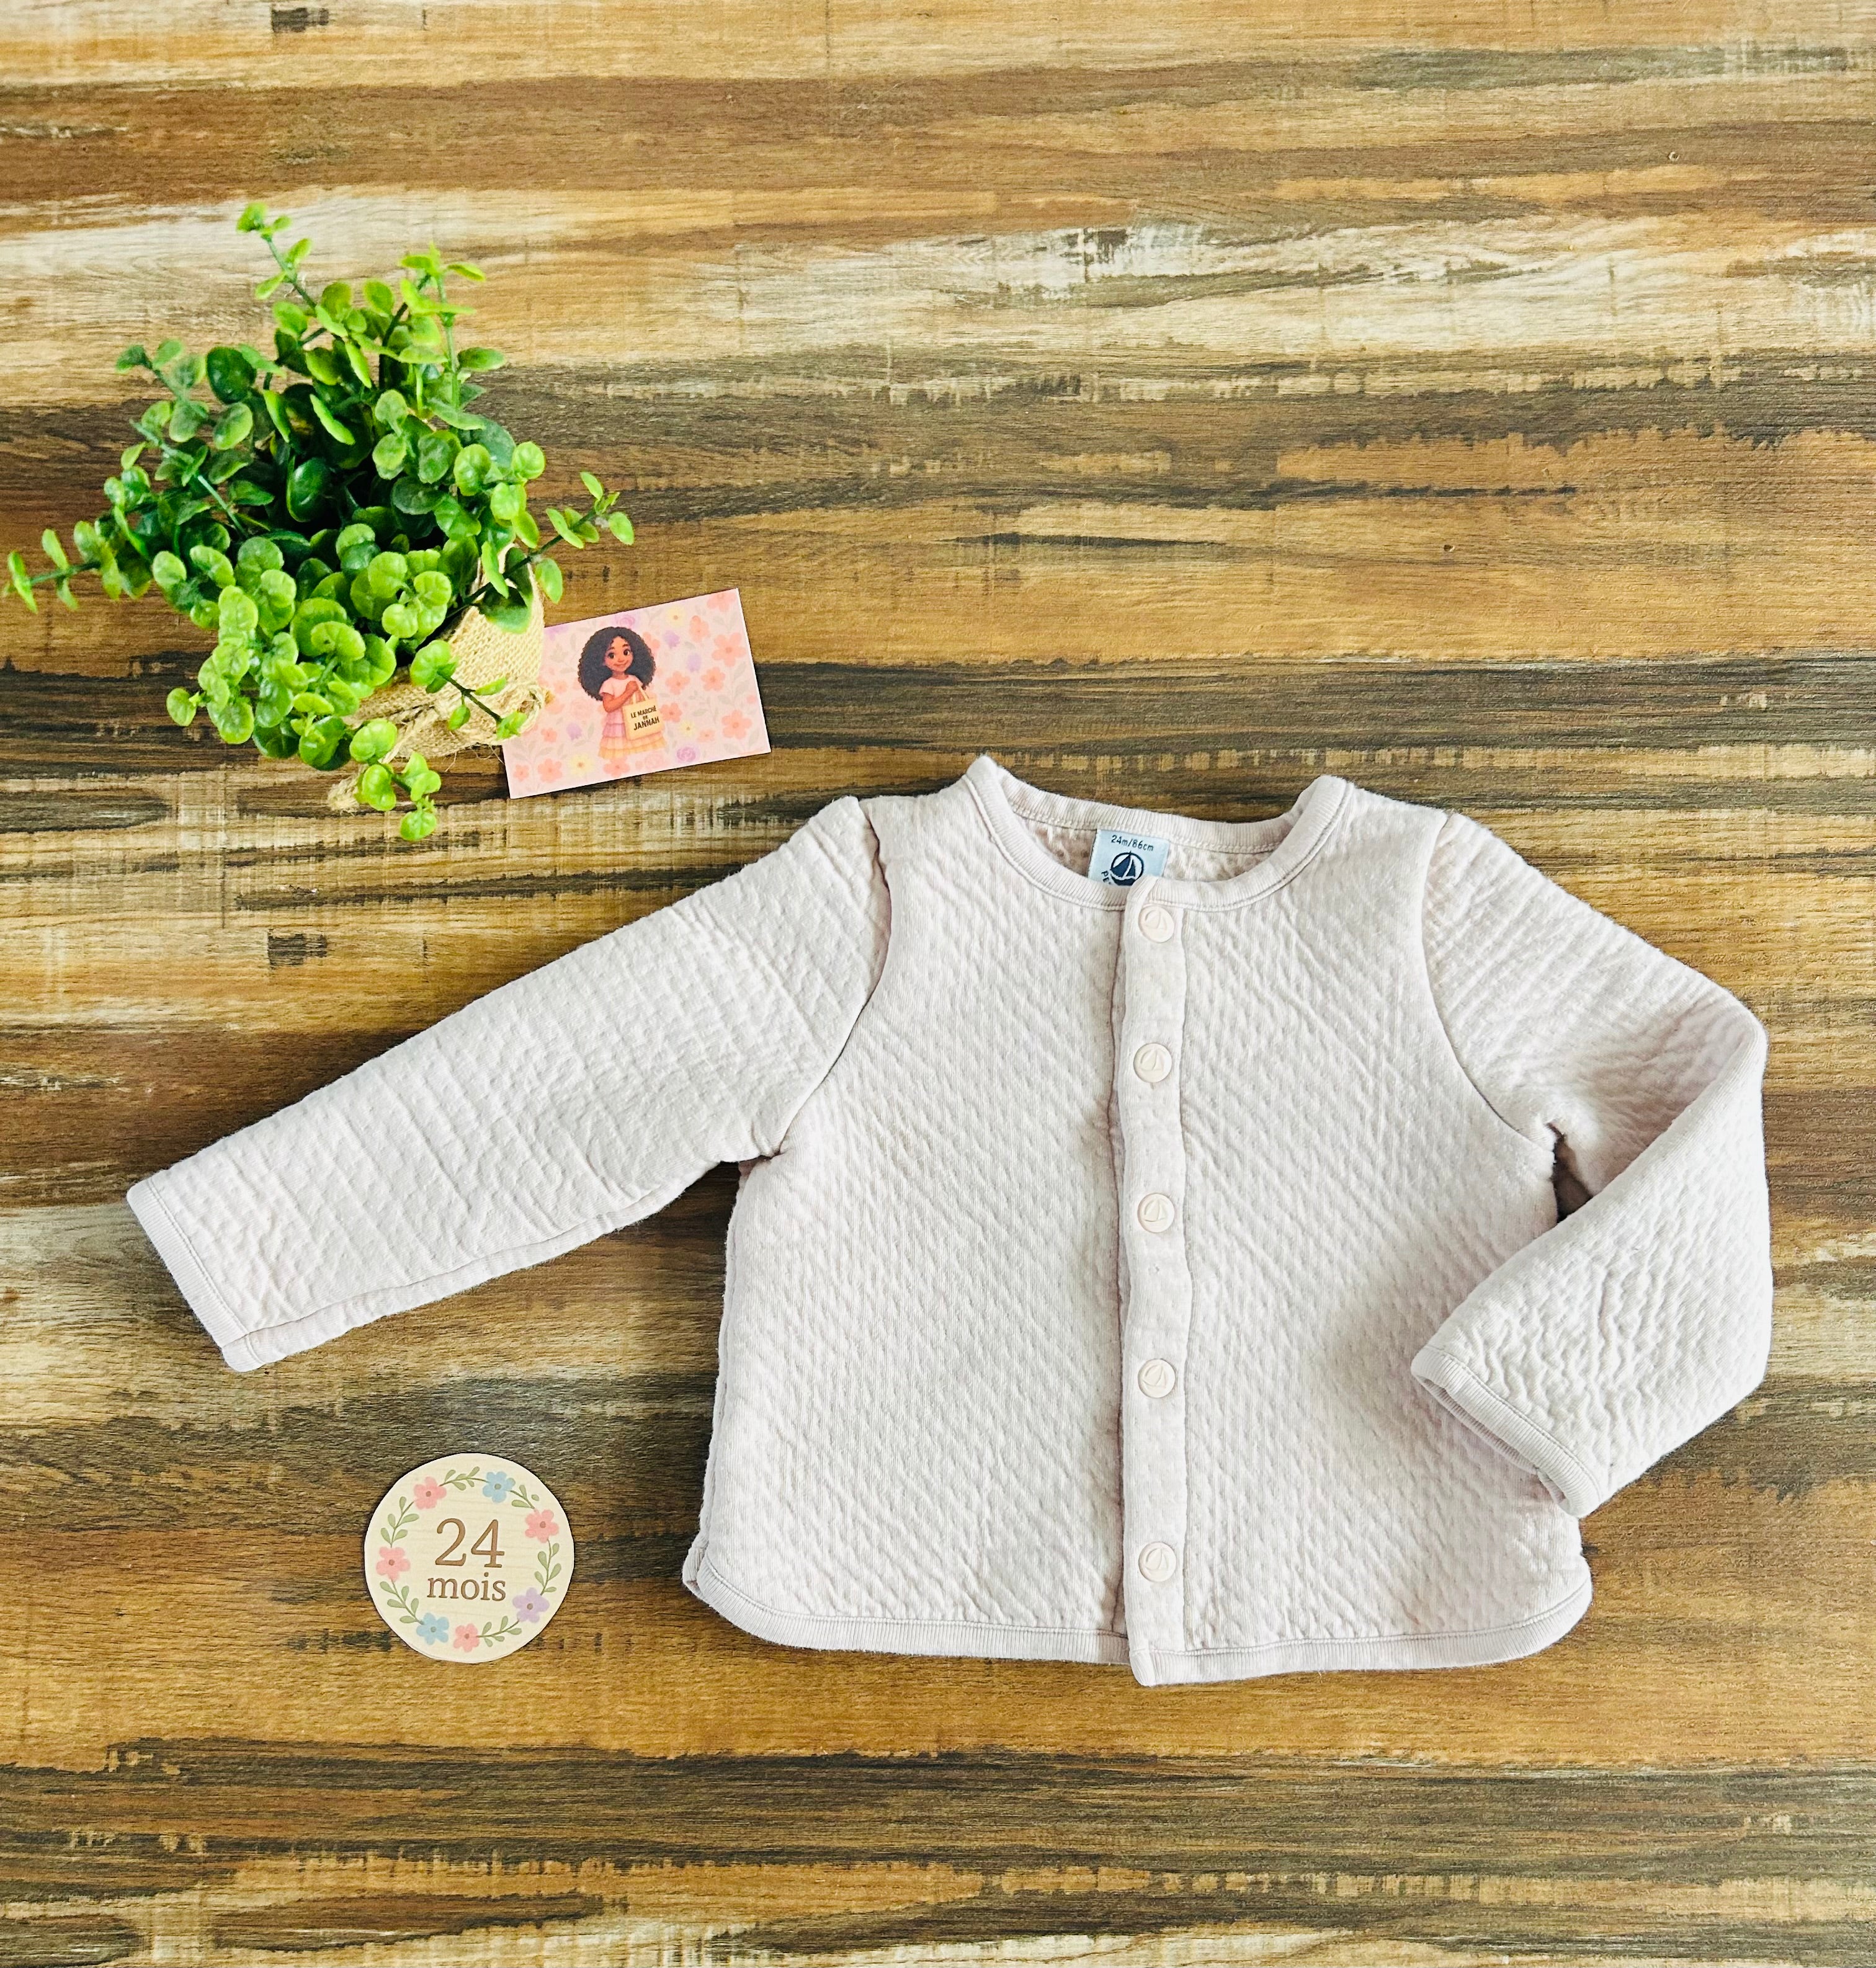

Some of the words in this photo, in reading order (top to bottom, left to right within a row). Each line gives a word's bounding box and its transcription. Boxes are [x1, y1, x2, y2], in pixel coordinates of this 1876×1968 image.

[633, 716, 659, 731] JANNAH
[1111, 834, 1154, 852] 24m/86cm
[1101, 870, 1112, 885] PE
[435, 1518, 505, 1568] 24
[427, 1572, 506, 1601] mois
